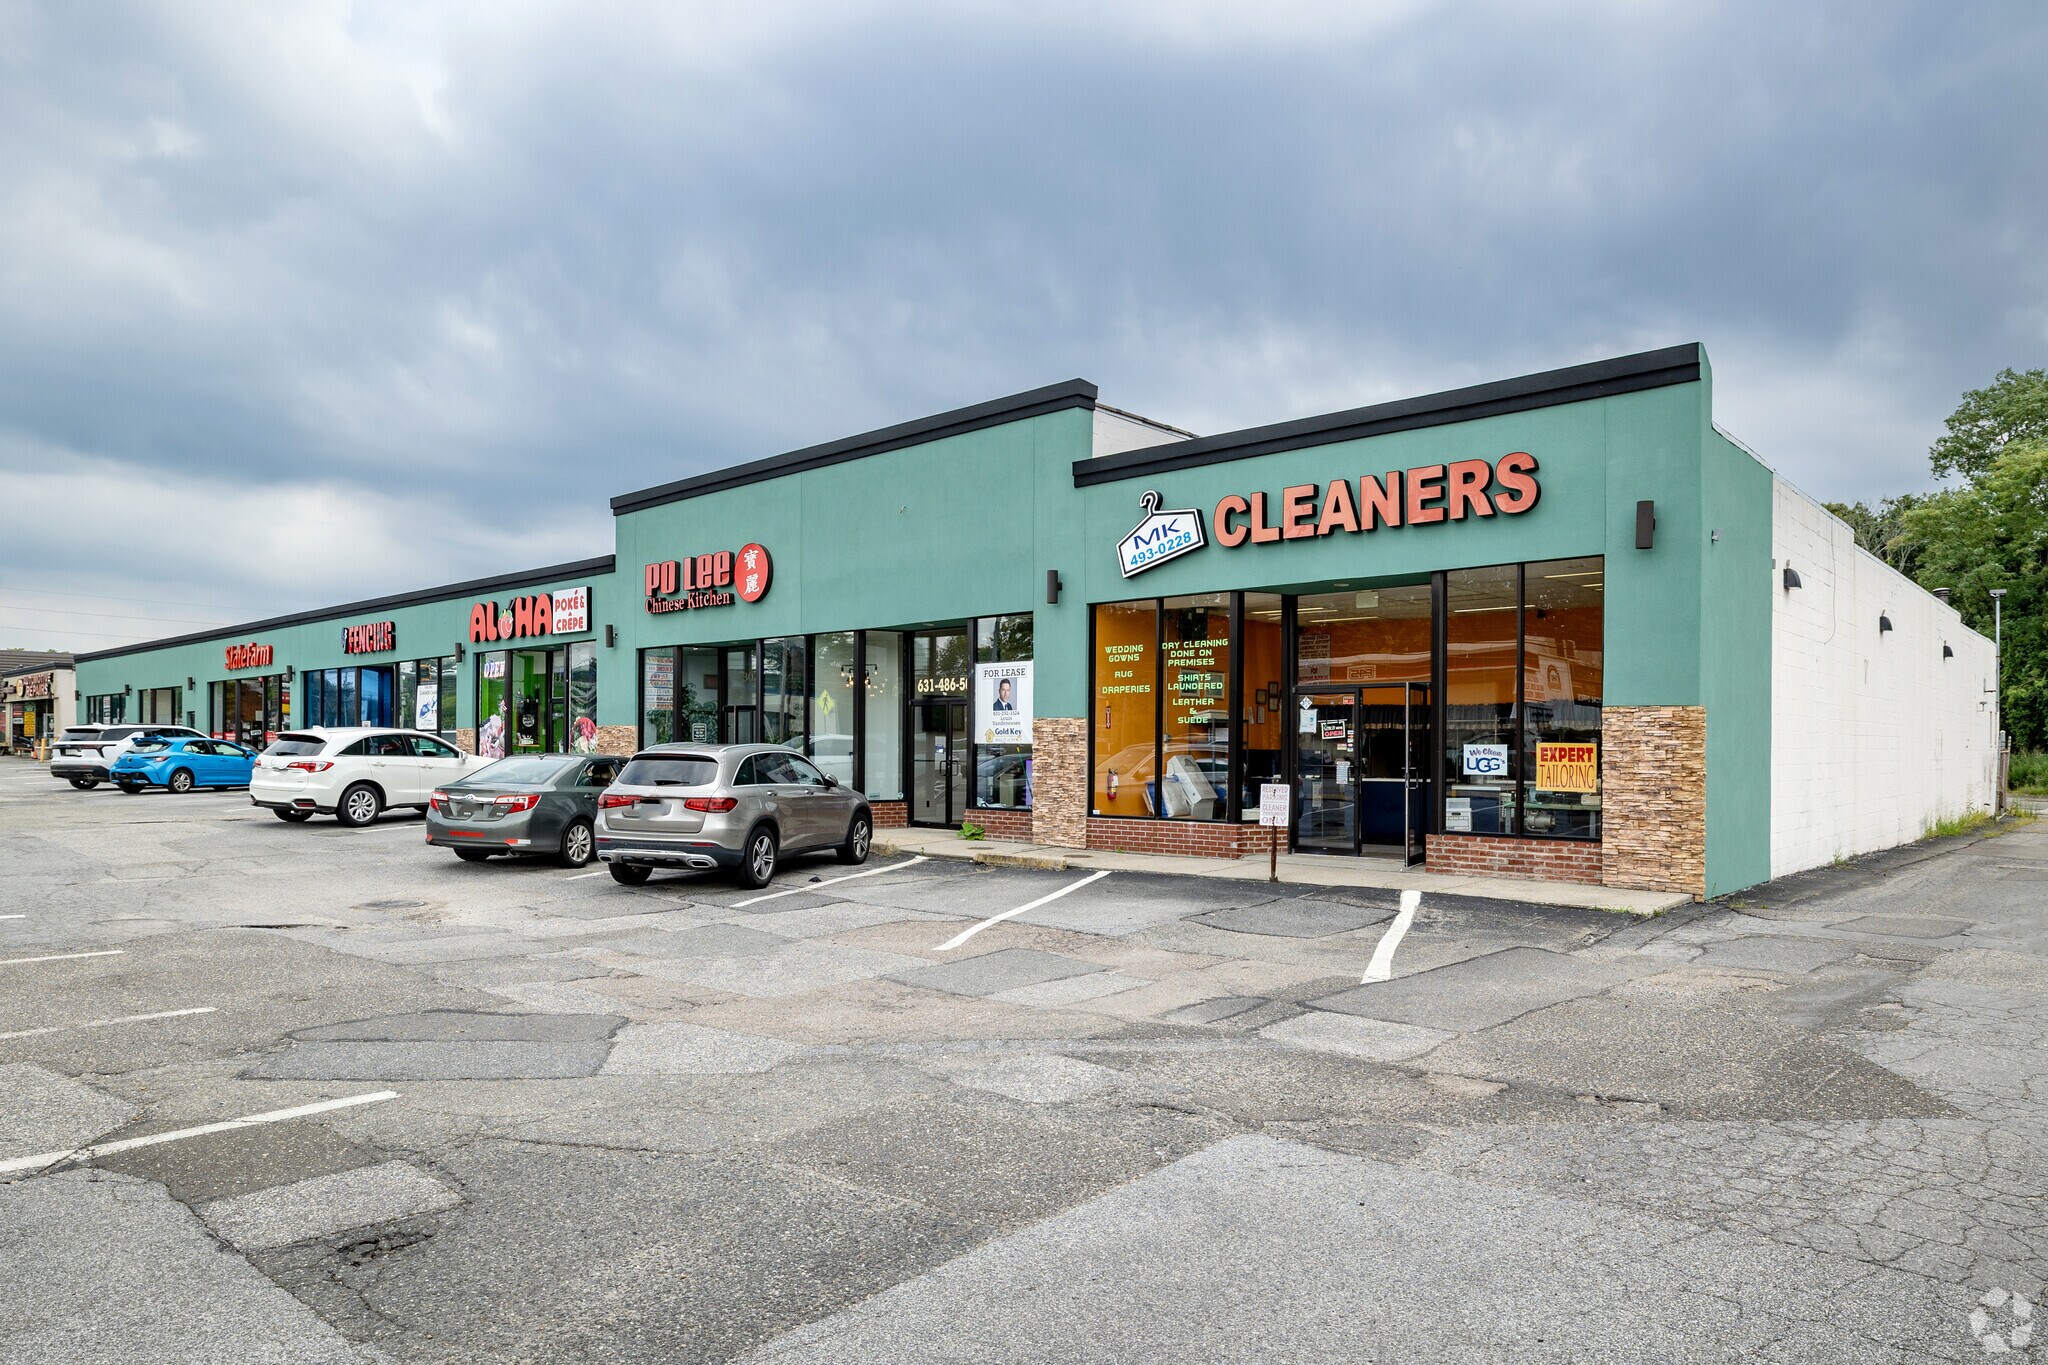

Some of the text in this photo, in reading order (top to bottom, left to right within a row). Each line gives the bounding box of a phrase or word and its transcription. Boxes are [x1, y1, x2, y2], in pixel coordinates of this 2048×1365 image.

[1213, 451, 1540, 547] CLEANERS
[1133, 518, 1181, 550] MK
[1130, 531, 1192, 565] 493-0228
[555, 589, 585, 612] POKÉ &
[645, 588, 731, 614] Chinese Kitchen
[348, 620, 393, 654] FENCING
[1104, 644, 1144, 654] WEDDING
[1162, 639, 1229, 650] DRY CLEANING
[1108, 653, 1140, 663] GOWNS
[1170, 649, 1213, 658] DONE ON
[1167, 658, 1215, 667] PREMISES
[984, 667, 1026, 678] FOR LEASE
[1114, 670, 1133, 678] RUG
[1177, 673, 1212, 682] SHIRTS
[1102, 684, 1151, 694] DRAPERIES
[1167, 682, 1223, 691] LAUNDERED
[1172, 698, 1215, 706] LEATHER
[1189, 707, 1197, 715] &
[1177, 716, 1209, 724] SUEDE
[1010, 728, 1023, 737] Key
[1469, 747, 1503, 757] We Clean
[1540, 746, 1594, 763] EXPERT
[1539, 763, 1595, 789] TAILORING
[1262, 785, 1288, 793] RESERVED
[1262, 803, 1287, 811] CLEANER
[1262, 816, 1287, 825] ONLY
